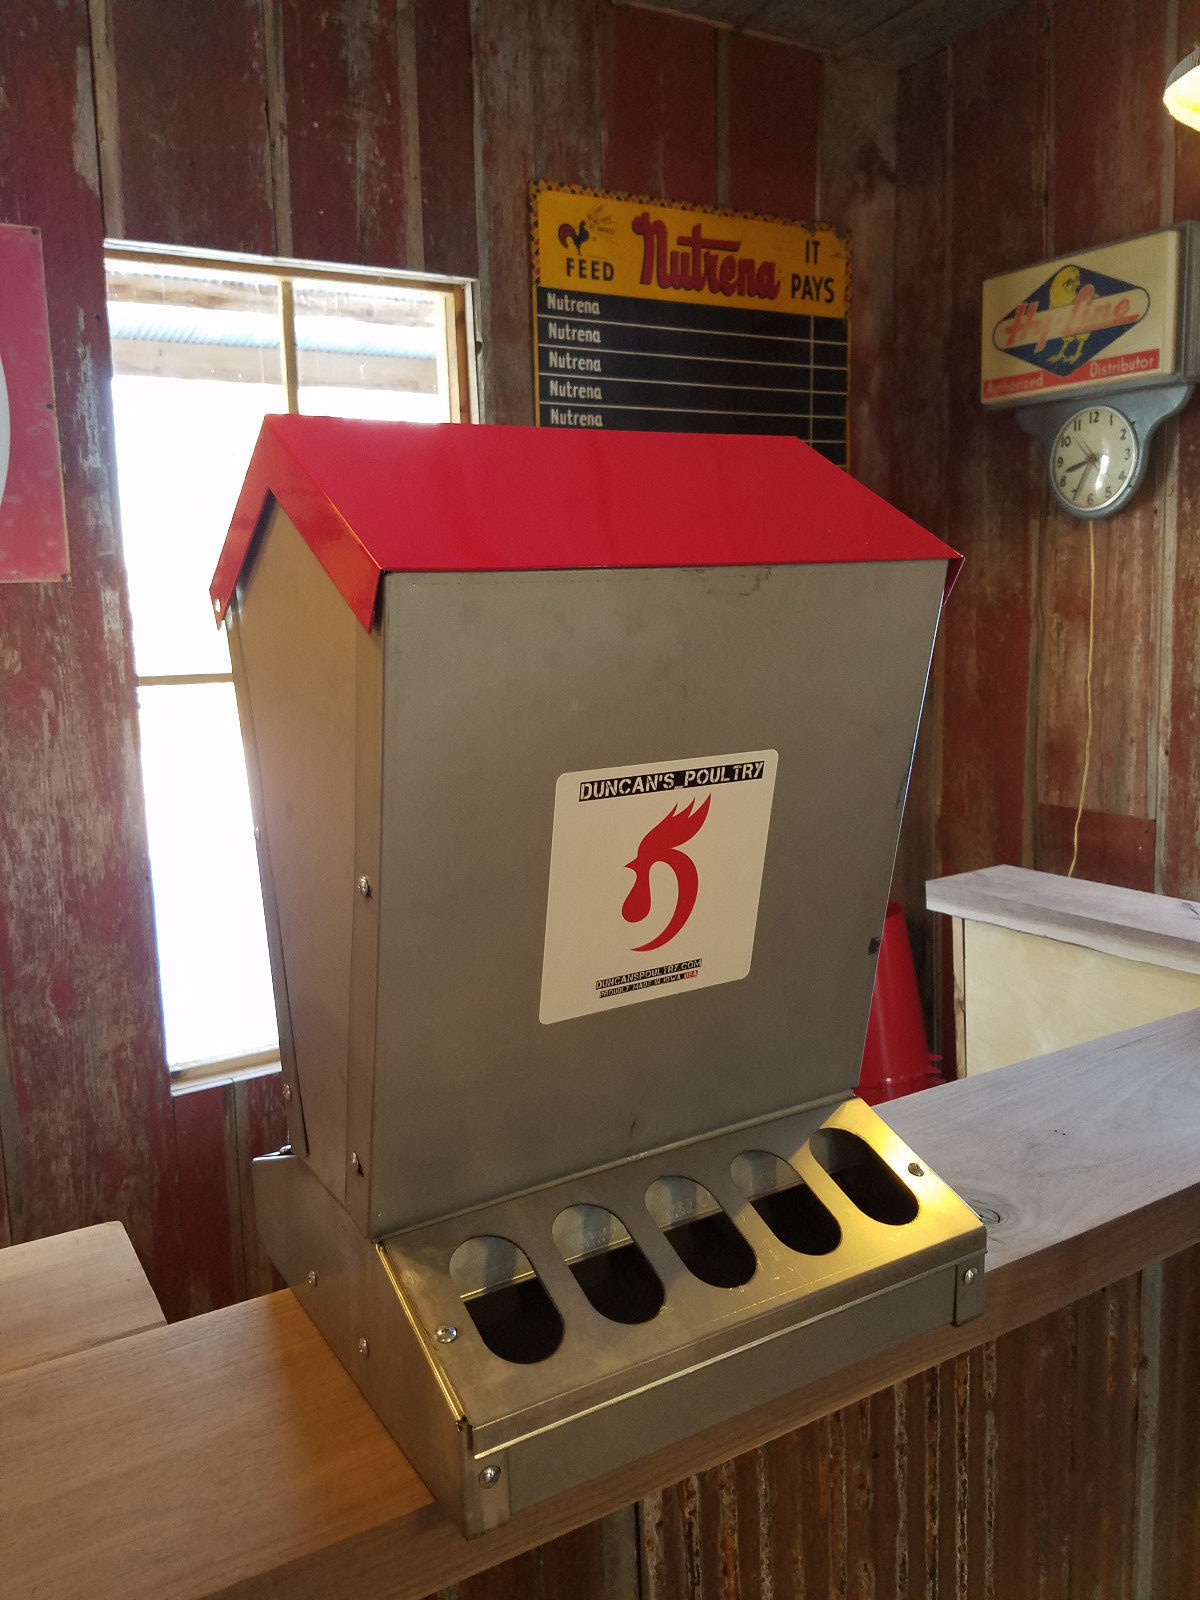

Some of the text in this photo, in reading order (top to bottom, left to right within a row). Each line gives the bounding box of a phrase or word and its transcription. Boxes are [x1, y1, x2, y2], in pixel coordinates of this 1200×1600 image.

[631, 211, 780, 300] Nutrena
[805, 239, 820, 264] IT
[566, 257, 614, 281] FEED
[791, 273, 835, 304] PAYS
[546, 292, 600, 315] Nutrena
[548, 322, 601, 343] Nutrena
[549, 351, 601, 372] Nutrena
[986, 355, 1154, 394] Ahorized Distributor
[549, 380, 602, 399] Nutrena
[550, 408, 603, 427] Nutrena
[1073, 418, 1081, 431] 11
[1089, 411, 1100, 424] 12
[1109, 414, 1113, 426] 1
[1061, 435, 1071, 448] 10
[1120, 428, 1127, 440] 2
[1057, 456, 1064, 468] 9
[1124, 448, 1131, 460] 3
[1060, 475, 1067, 488] 8
[1087, 493, 1094, 505] 6
[1105, 486, 1112, 498] 5
[580, 761, 764, 800] DUNCAN'S POULTRY
[596, 958, 702, 990] DUNCANSPOULTRY.COM
[600, 985, 631, 998] PROUDLY
[663, 974, 681, 984] IOWA
